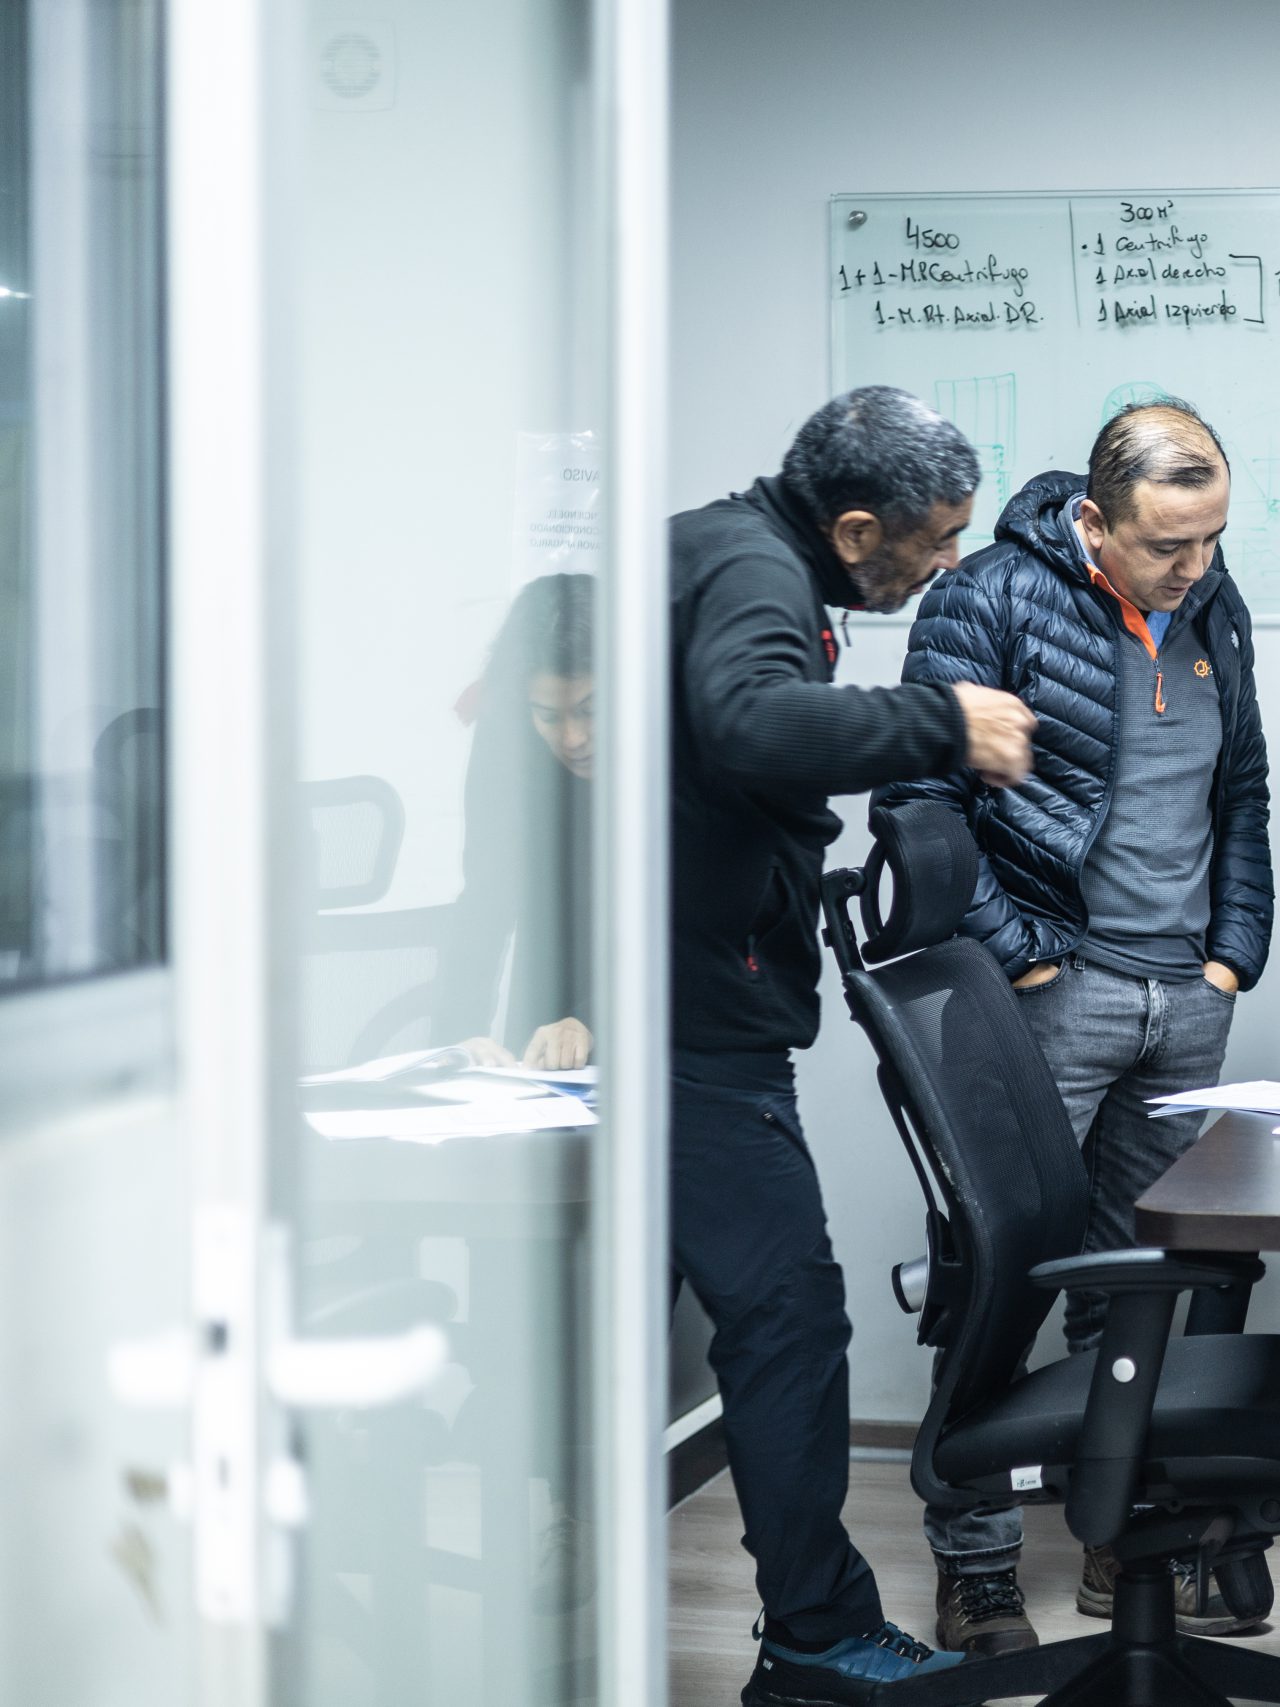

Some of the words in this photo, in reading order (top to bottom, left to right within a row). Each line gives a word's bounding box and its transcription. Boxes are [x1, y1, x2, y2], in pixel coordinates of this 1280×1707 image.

[906, 216, 960, 250] 4500
[1096, 266, 1108, 285] 1
[1097, 298, 1108, 322] 1
[1114, 294, 1158, 323] Axial
